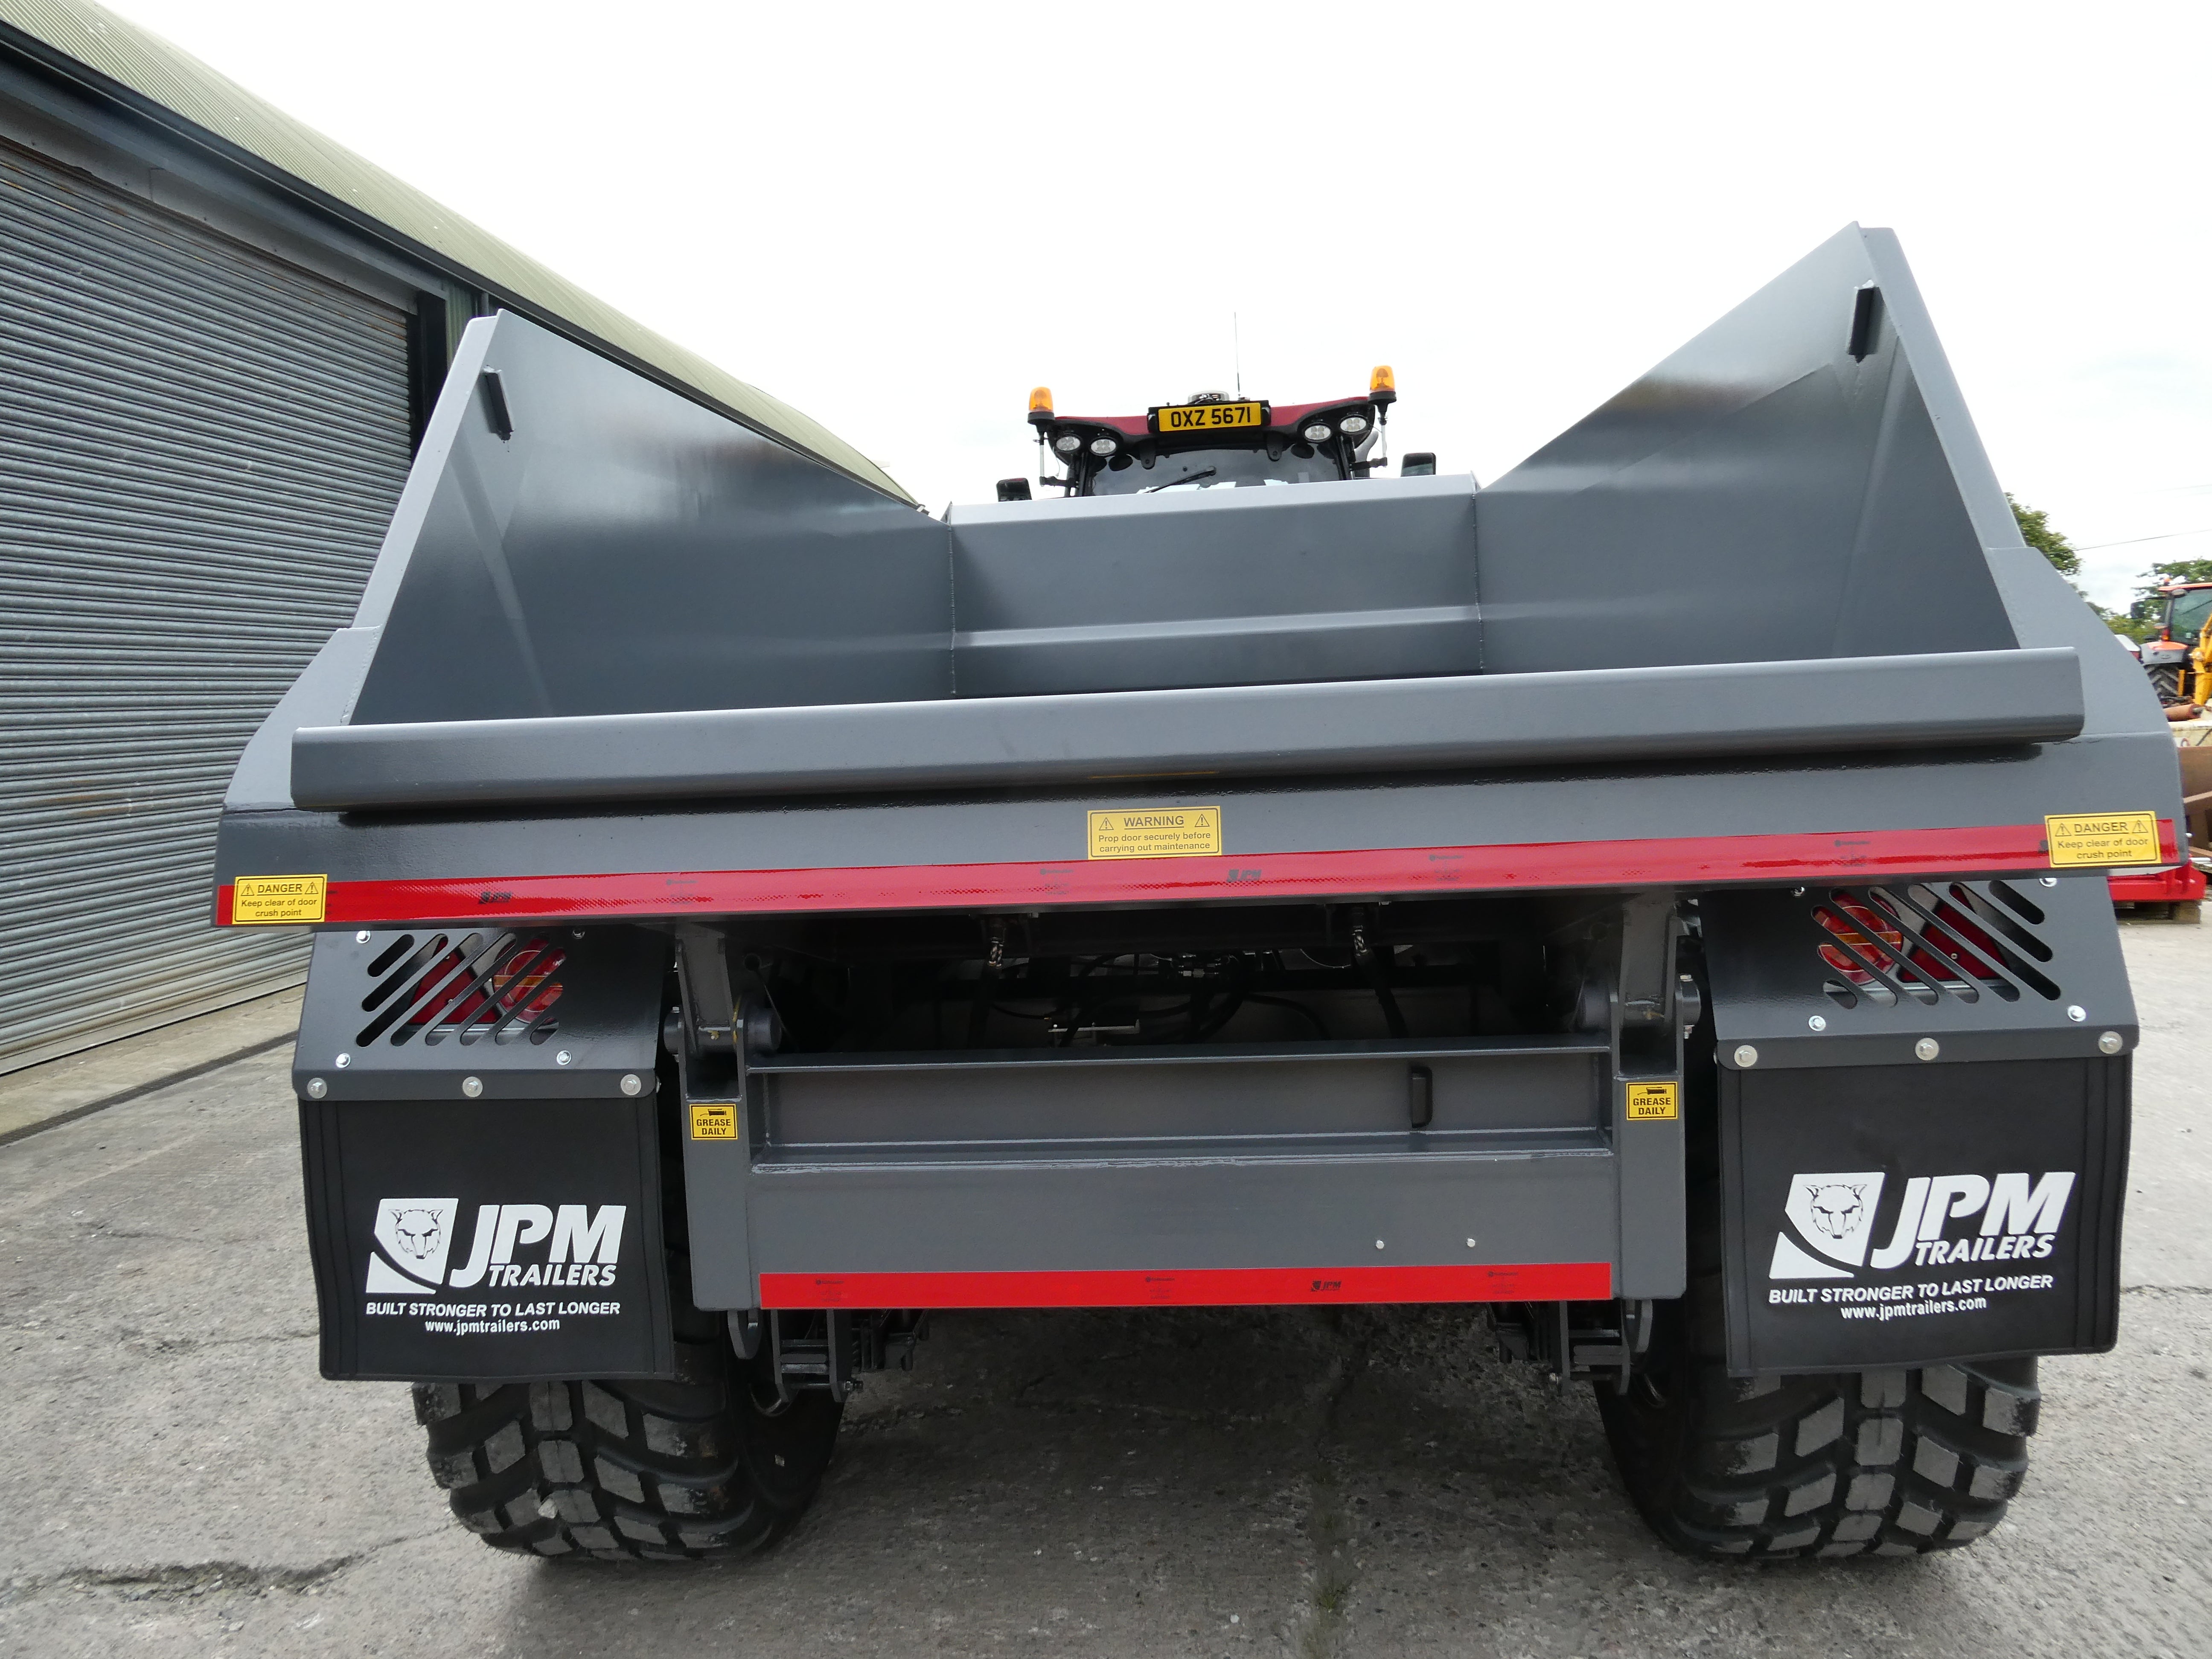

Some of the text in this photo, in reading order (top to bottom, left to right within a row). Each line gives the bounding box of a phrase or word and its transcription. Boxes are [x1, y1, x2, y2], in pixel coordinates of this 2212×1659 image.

[1171, 407, 1250, 427] OXZ 5671
[1123, 815, 1184, 827] WARNING
[2074, 822, 2128, 832] DANGER
[1099, 835, 1118, 843] Prop
[1144, 833, 1180, 841] securely
[2058, 840, 2083, 849] Keep
[2086, 839, 2110, 847] clear
[1100, 844, 1134, 853] carrying
[2107, 850, 2132, 859] point
[258, 884, 303, 893] DANGER
[1633, 1097, 1671, 1106] GREASE
[1870, 1172, 2076, 1269] JPM
[449, 1204, 626, 1288] JPM
[1915, 1234, 2056, 1266] TRAILERS
[488, 1264, 617, 1287] TRAILERS
[1769, 1275, 2054, 1304] BUILT STRONGER TO LAST LONGER
[366, 1302, 621, 1317] BUILT STRONGER TO LAST LONGER
[1841, 1296, 1987, 1321] www.jpmtrailers.com
[425, 1318, 560, 1336] www.jpmtrailers.com
